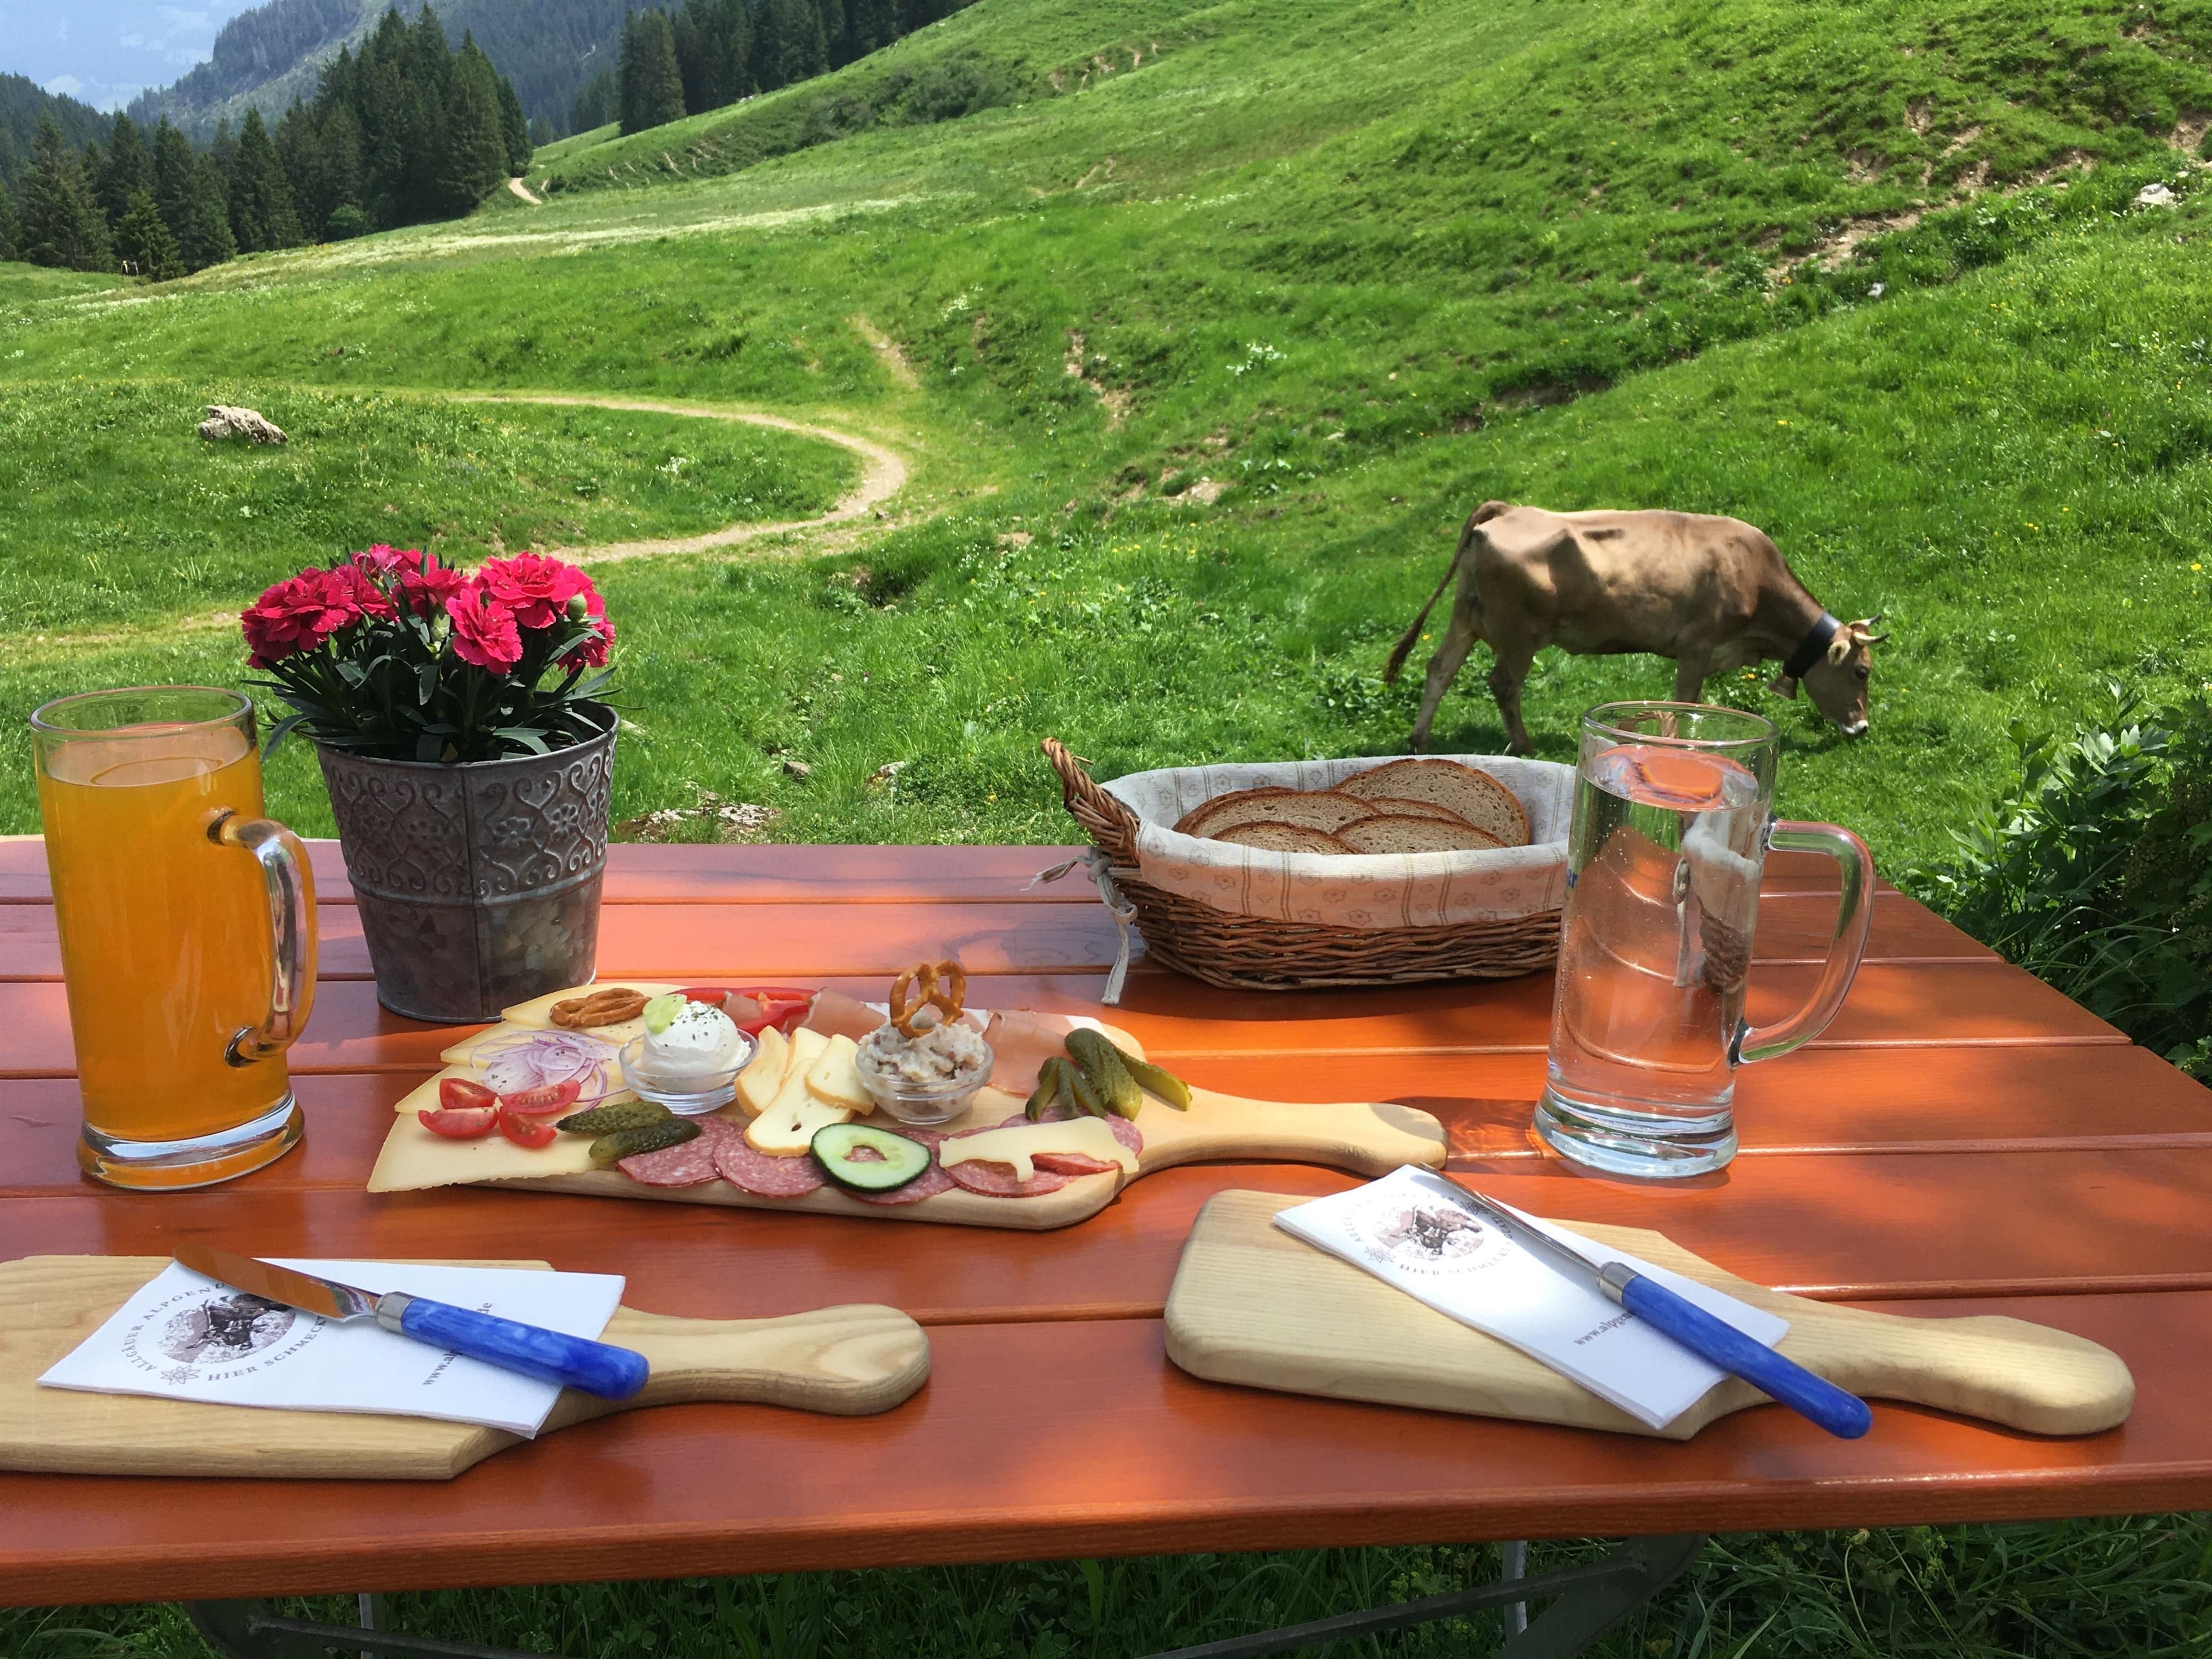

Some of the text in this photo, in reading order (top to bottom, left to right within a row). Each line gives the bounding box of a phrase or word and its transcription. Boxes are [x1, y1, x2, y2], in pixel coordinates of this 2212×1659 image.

[143, 1282, 225, 1321] ALPGENO
[1574, 1311, 1635, 1345] www.alpgen
[207, 1366, 258, 1381] HIER
